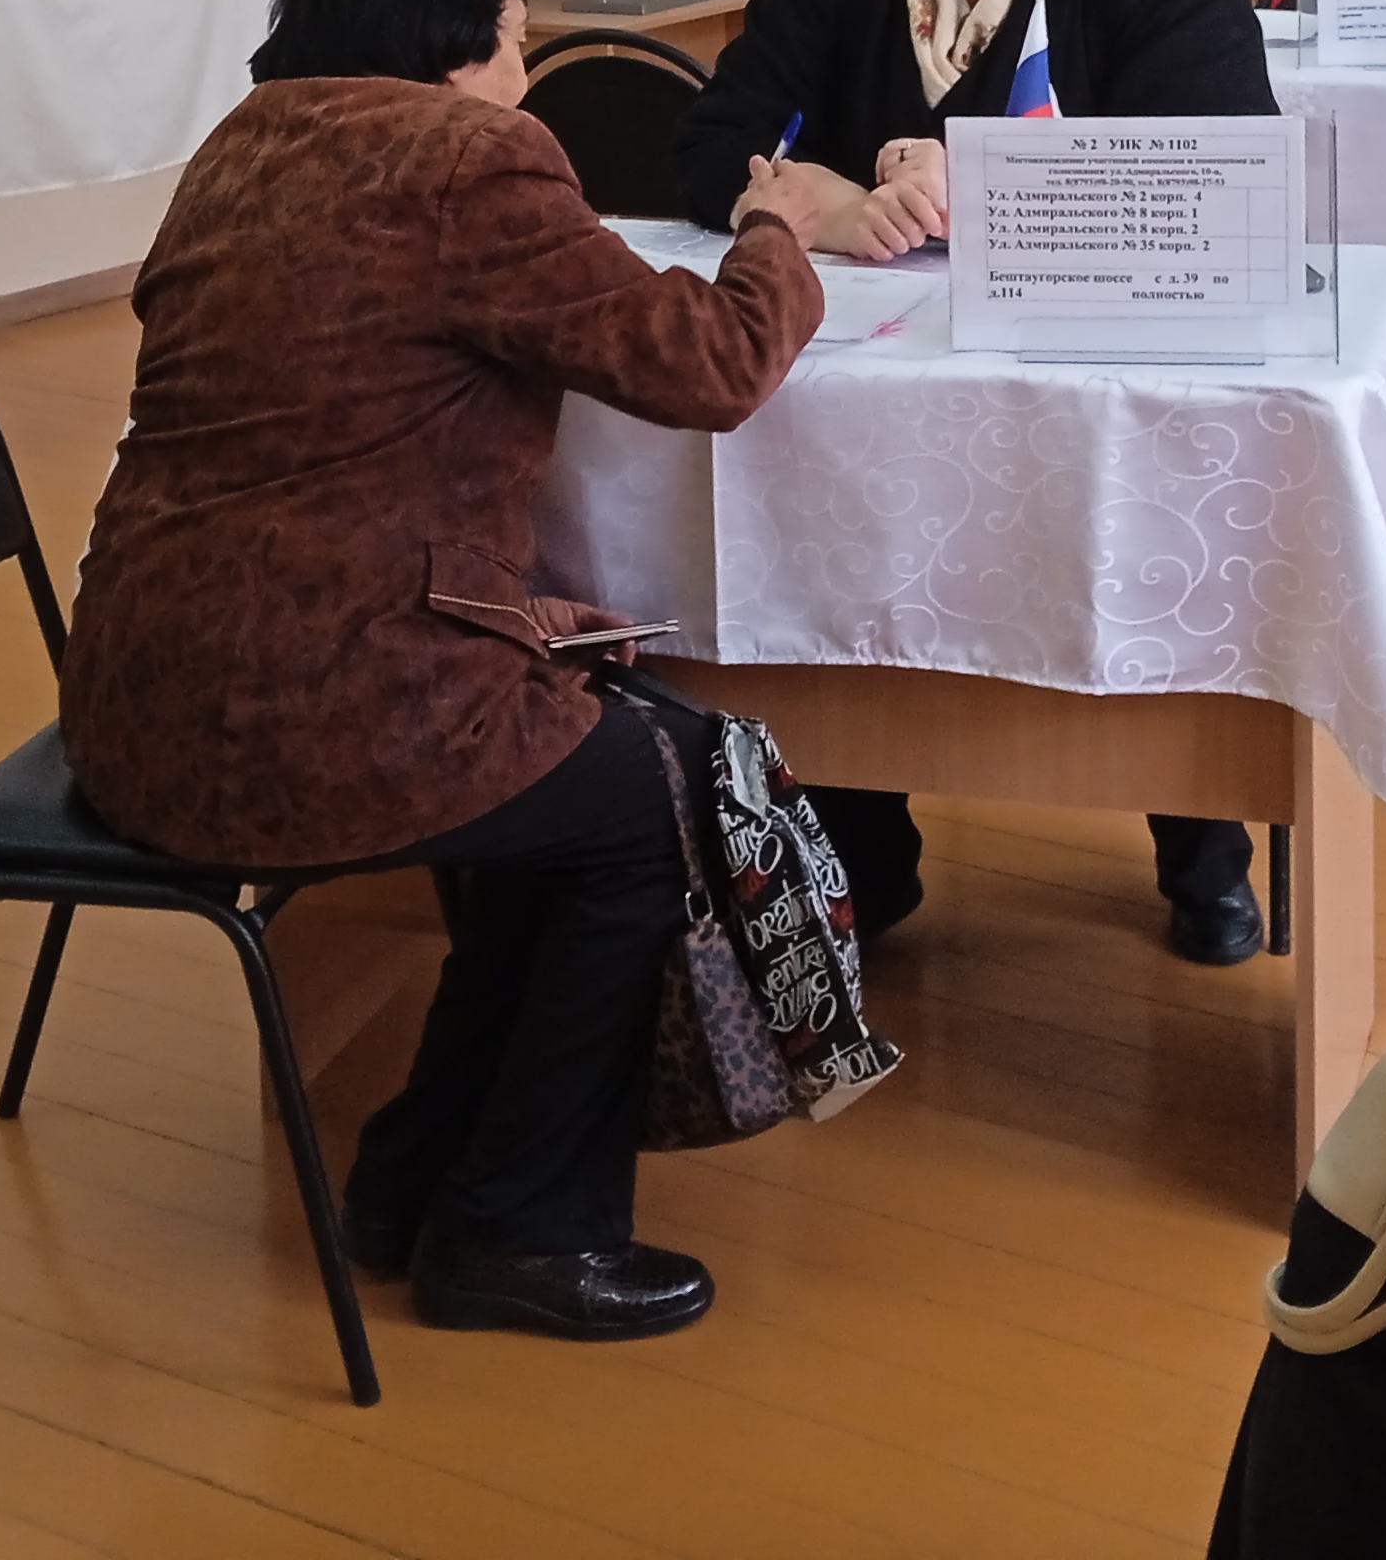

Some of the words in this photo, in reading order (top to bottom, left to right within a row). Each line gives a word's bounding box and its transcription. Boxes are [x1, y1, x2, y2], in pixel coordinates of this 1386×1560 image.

[1090, 138, 1097, 150] 2
[1109, 139, 1142, 151] УИК
[1168, 139, 1198, 151] 1102
[987, 190, 1010, 201] Ул.
[1013, 190, 1118, 204] Адмиральского
[1139, 191, 1147, 201] 2
[1150, 193, 1187, 204] корп.
[1194, 191, 1202, 202] 4
[988, 206, 1011, 217] Ул.
[1013, 207, 1118, 220] Адмиральского
[1139, 207, 1147, 218] 8
[1150, 209, 1187, 221] корп.
[1192, 207, 1198, 218] 1
[988, 222, 1011, 234] Ул.
[1013, 223, 1118, 236] Адмиральского
[1139, 224, 1148, 234] 8
[1151, 226, 1187, 237] корп.
[1192, 224, 1199, 235] 2
[988, 239, 1011, 250] Ул.
[1014, 239, 1119, 252] Адмиральского
[1139, 240, 1155, 251] 35
[1158, 242, 1196, 254] корп.
[1203, 241, 1210, 251] 2
[989, 271, 1091, 285] Бештаугорское
[1093, 274, 1133, 284] шоссе
[1154, 275, 1162, 284] с
[1168, 275, 1180, 284] д.
[1183, 272, 1199, 284] 39
[1213, 275, 1229, 284] по
[988, 288, 1023, 299] д.114
[1131, 291, 1205, 300] полностью
